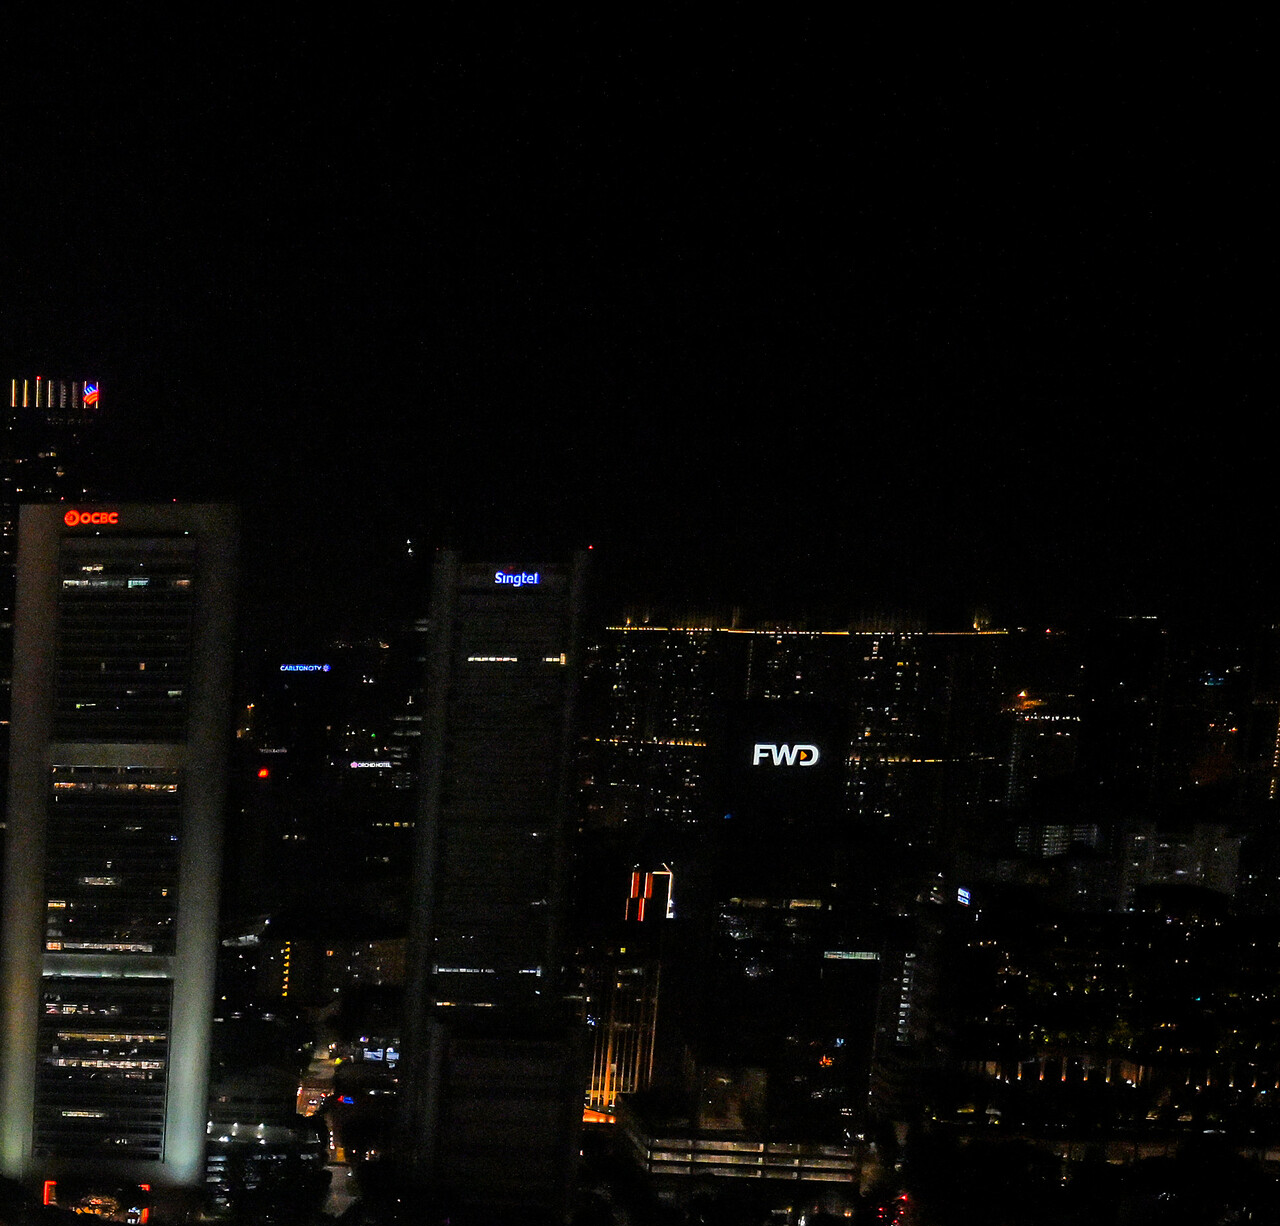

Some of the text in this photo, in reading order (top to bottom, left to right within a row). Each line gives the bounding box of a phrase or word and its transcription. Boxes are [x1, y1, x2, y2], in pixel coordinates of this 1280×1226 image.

[80, 512, 119, 524] OCBC
[495, 571, 540, 587] Singtel
[753, 744, 819, 766] FWD
